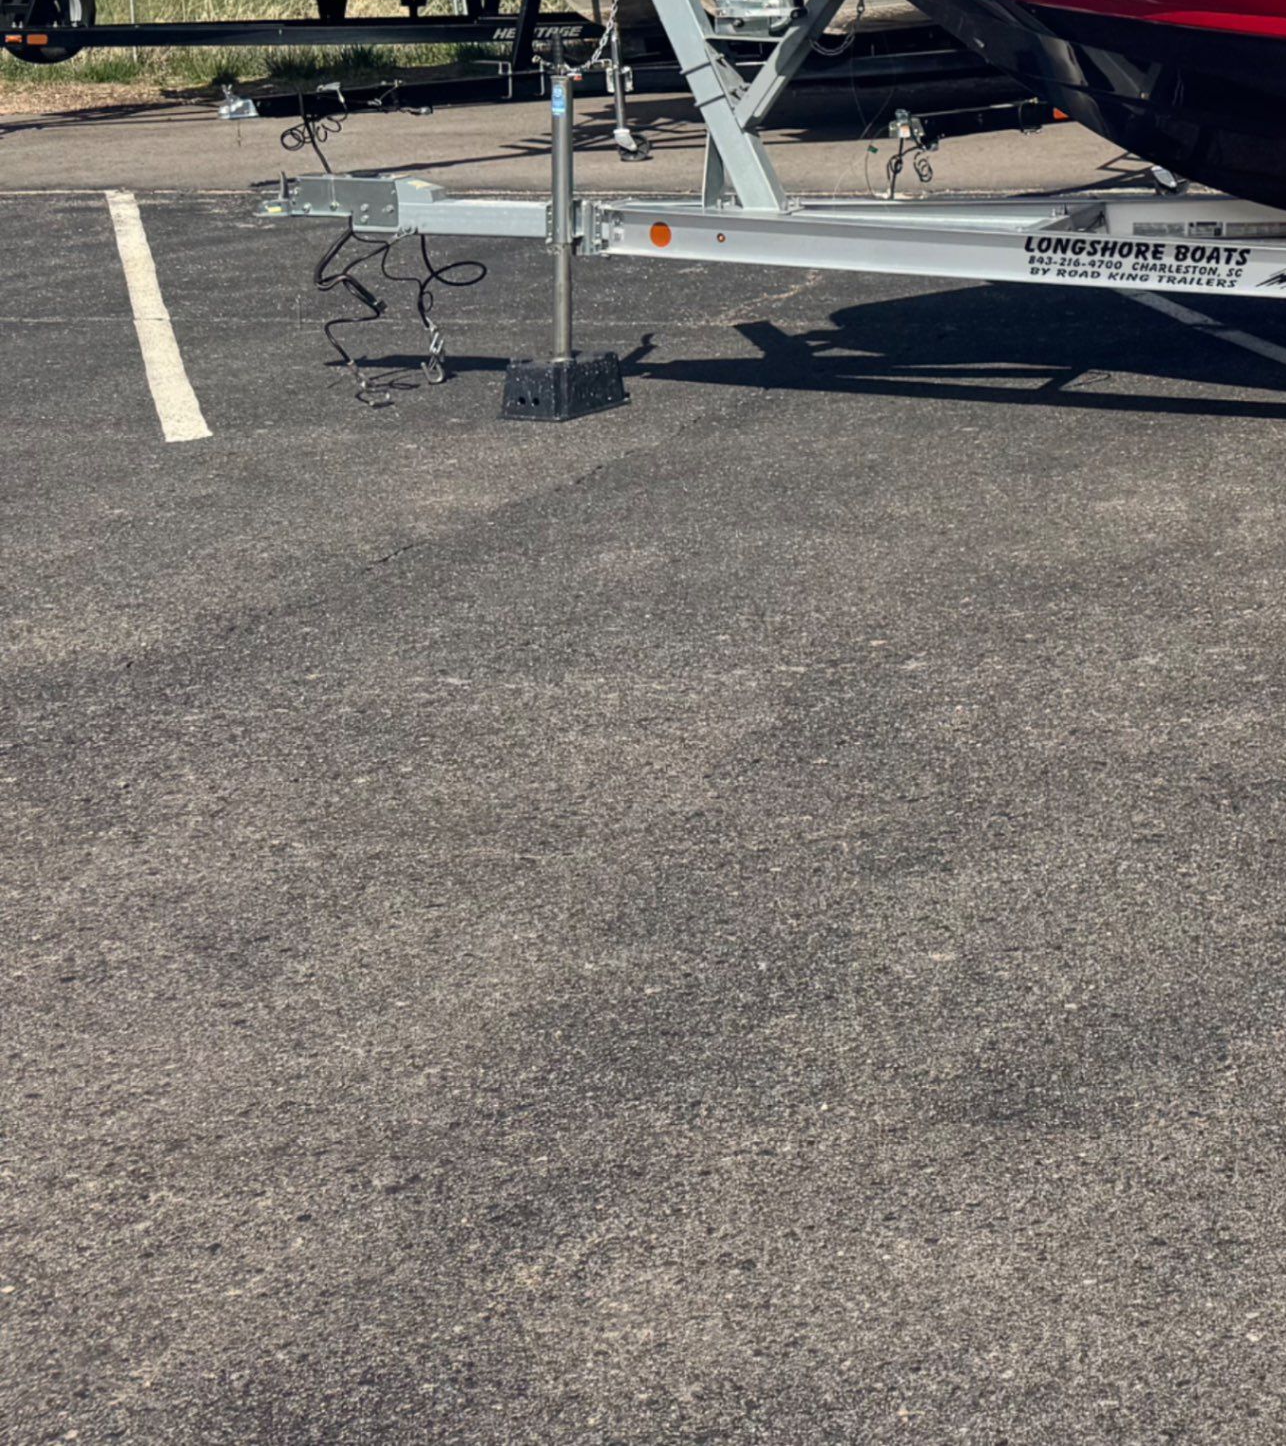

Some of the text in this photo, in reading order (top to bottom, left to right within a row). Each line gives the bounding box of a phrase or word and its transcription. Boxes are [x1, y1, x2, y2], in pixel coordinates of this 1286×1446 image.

[492, 26, 583, 40] HETAGE
[1024, 236, 1251, 266] LONGSHORE BOATS
[1028, 255, 1243, 277] 843-216-4700 CHARLESTON, SC
[1030, 267, 1238, 288] BY ROAD KING TRAILERS
